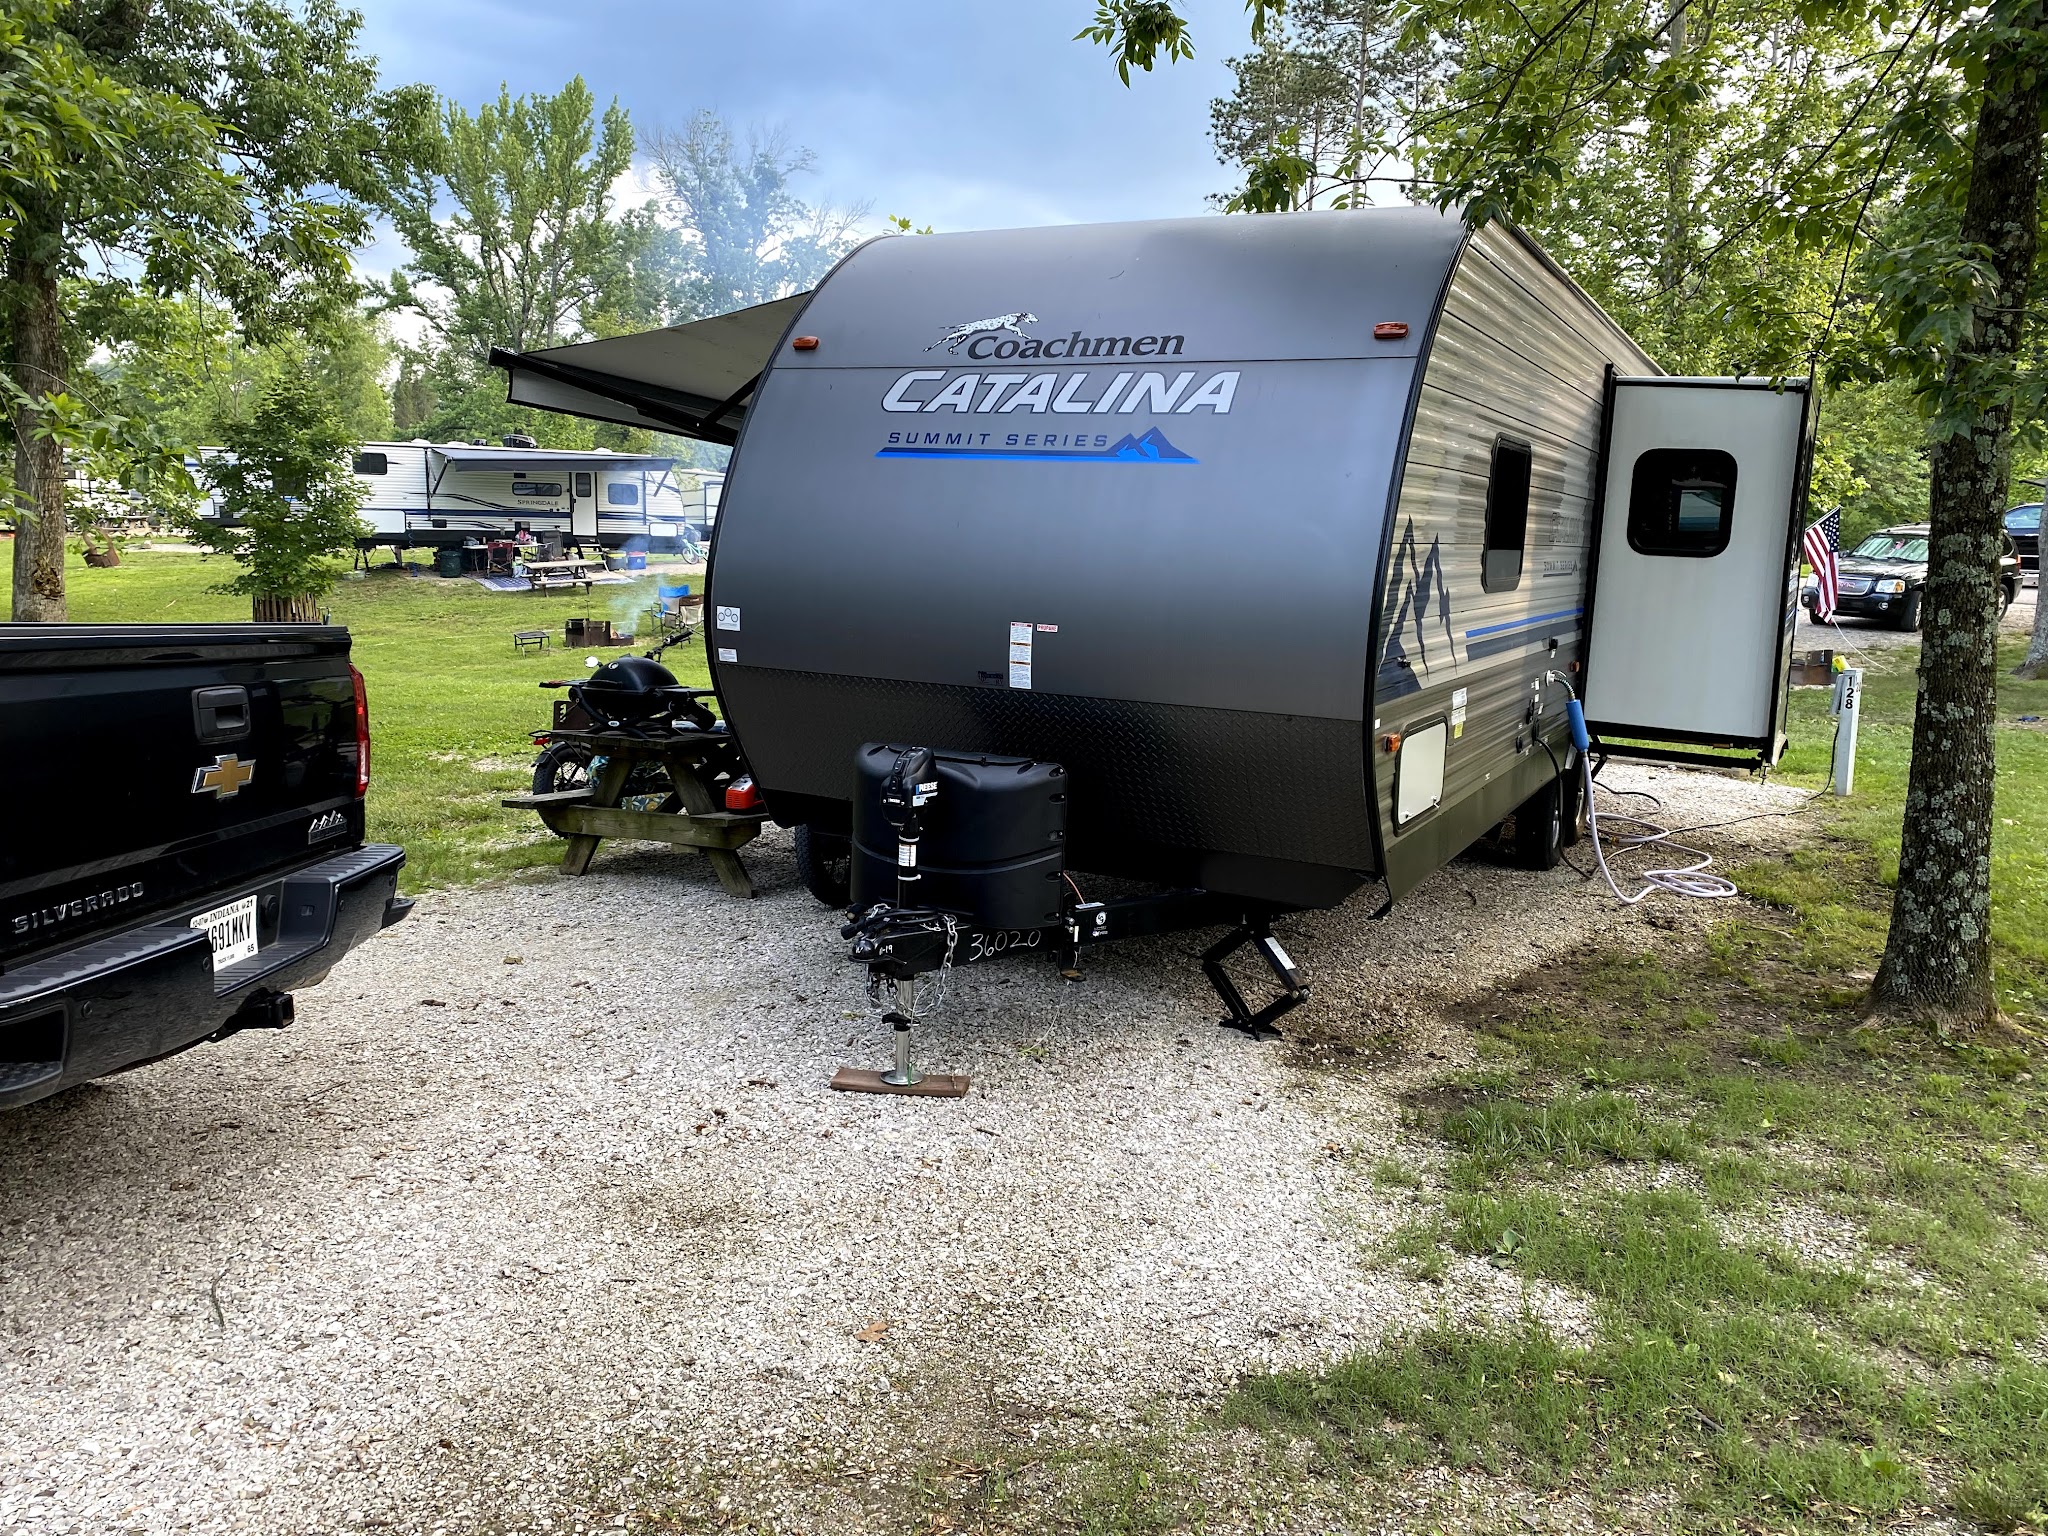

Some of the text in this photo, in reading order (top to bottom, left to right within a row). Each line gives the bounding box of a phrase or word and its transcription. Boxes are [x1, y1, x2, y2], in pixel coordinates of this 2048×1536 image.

[968, 331, 1185, 360] Coachmen
[881, 369, 1242, 415] CATALINA
[888, 432, 1108, 447] SUMMIT SERIES
[1845, 676, 1855, 710] 128
[919, 781, 939, 793] REESE
[12, 881, 145, 935] SILVERADO
[209, 904, 239, 922] INDIANA
[208, 911, 252, 954] 691MKV
[969, 929, 1041, 961] 36020
[247, 943, 255, 953] 65
